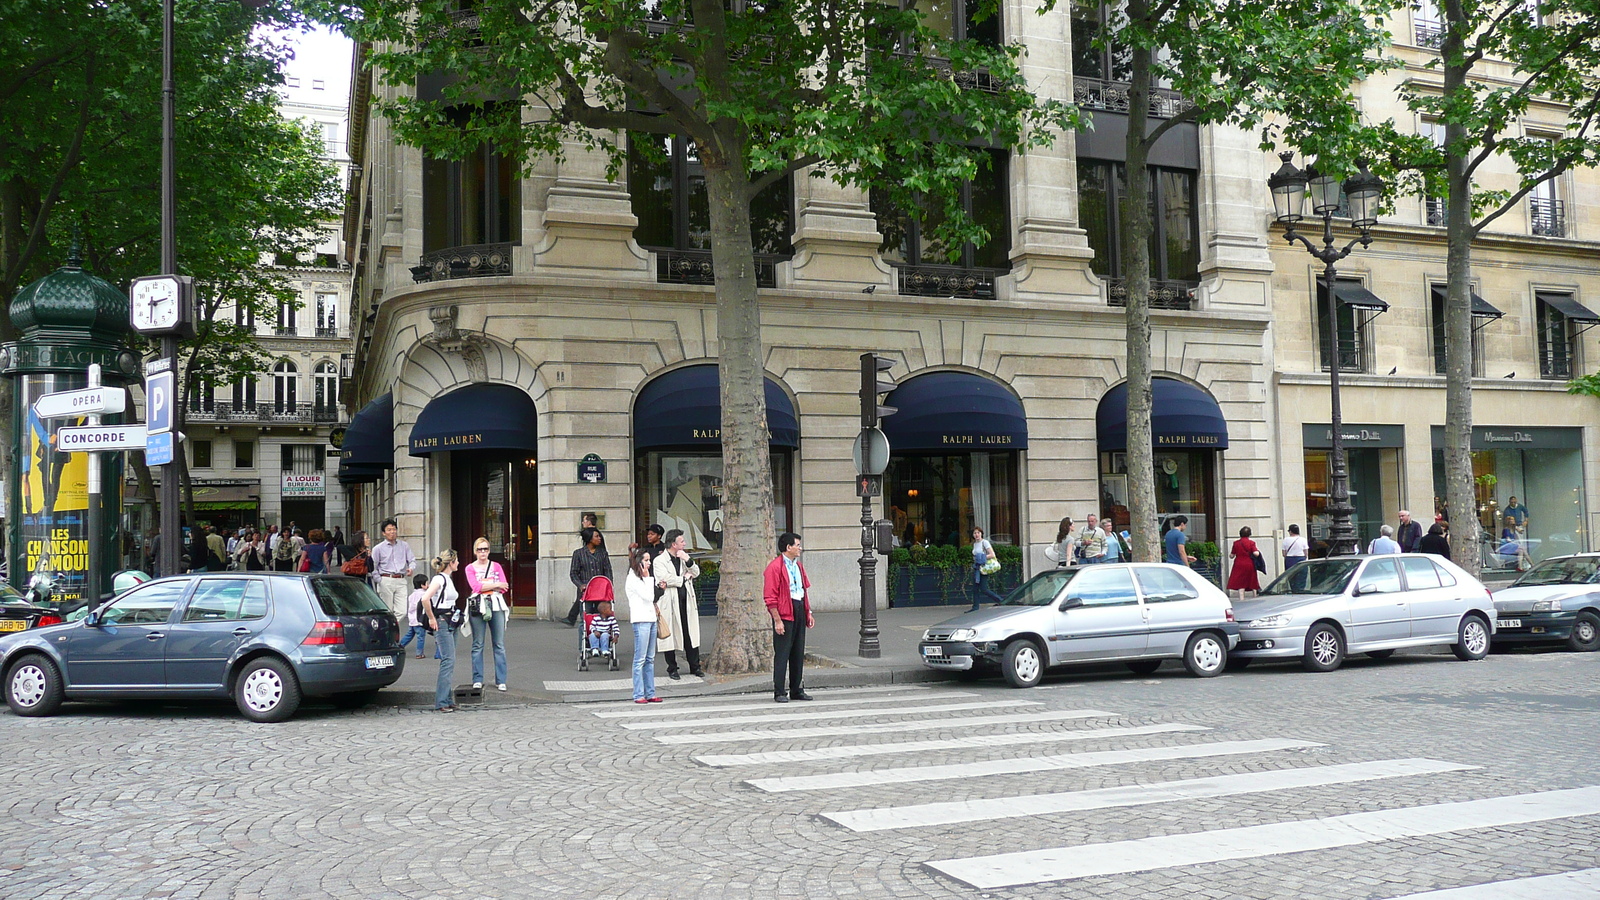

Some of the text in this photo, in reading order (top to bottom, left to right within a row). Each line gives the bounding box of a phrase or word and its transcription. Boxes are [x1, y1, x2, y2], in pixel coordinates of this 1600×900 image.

[72, 394, 102, 407] OPÉRA
[153, 387, 164, 422] P
[64, 432, 125, 444] CONCORDE
[693, 429, 720, 438] RALP
[942, 435, 1012, 444] RALPH LAUREN
[1159, 435, 1219, 444] RALPH LAUREN
[1326, 429, 1360, 440] Mssimo
[414, 433, 482, 448] RALPH LAUREN
[51, 528, 70, 541] LES
[27, 539, 89, 555] CHANSON
[15, 621, 24, 629] 75
